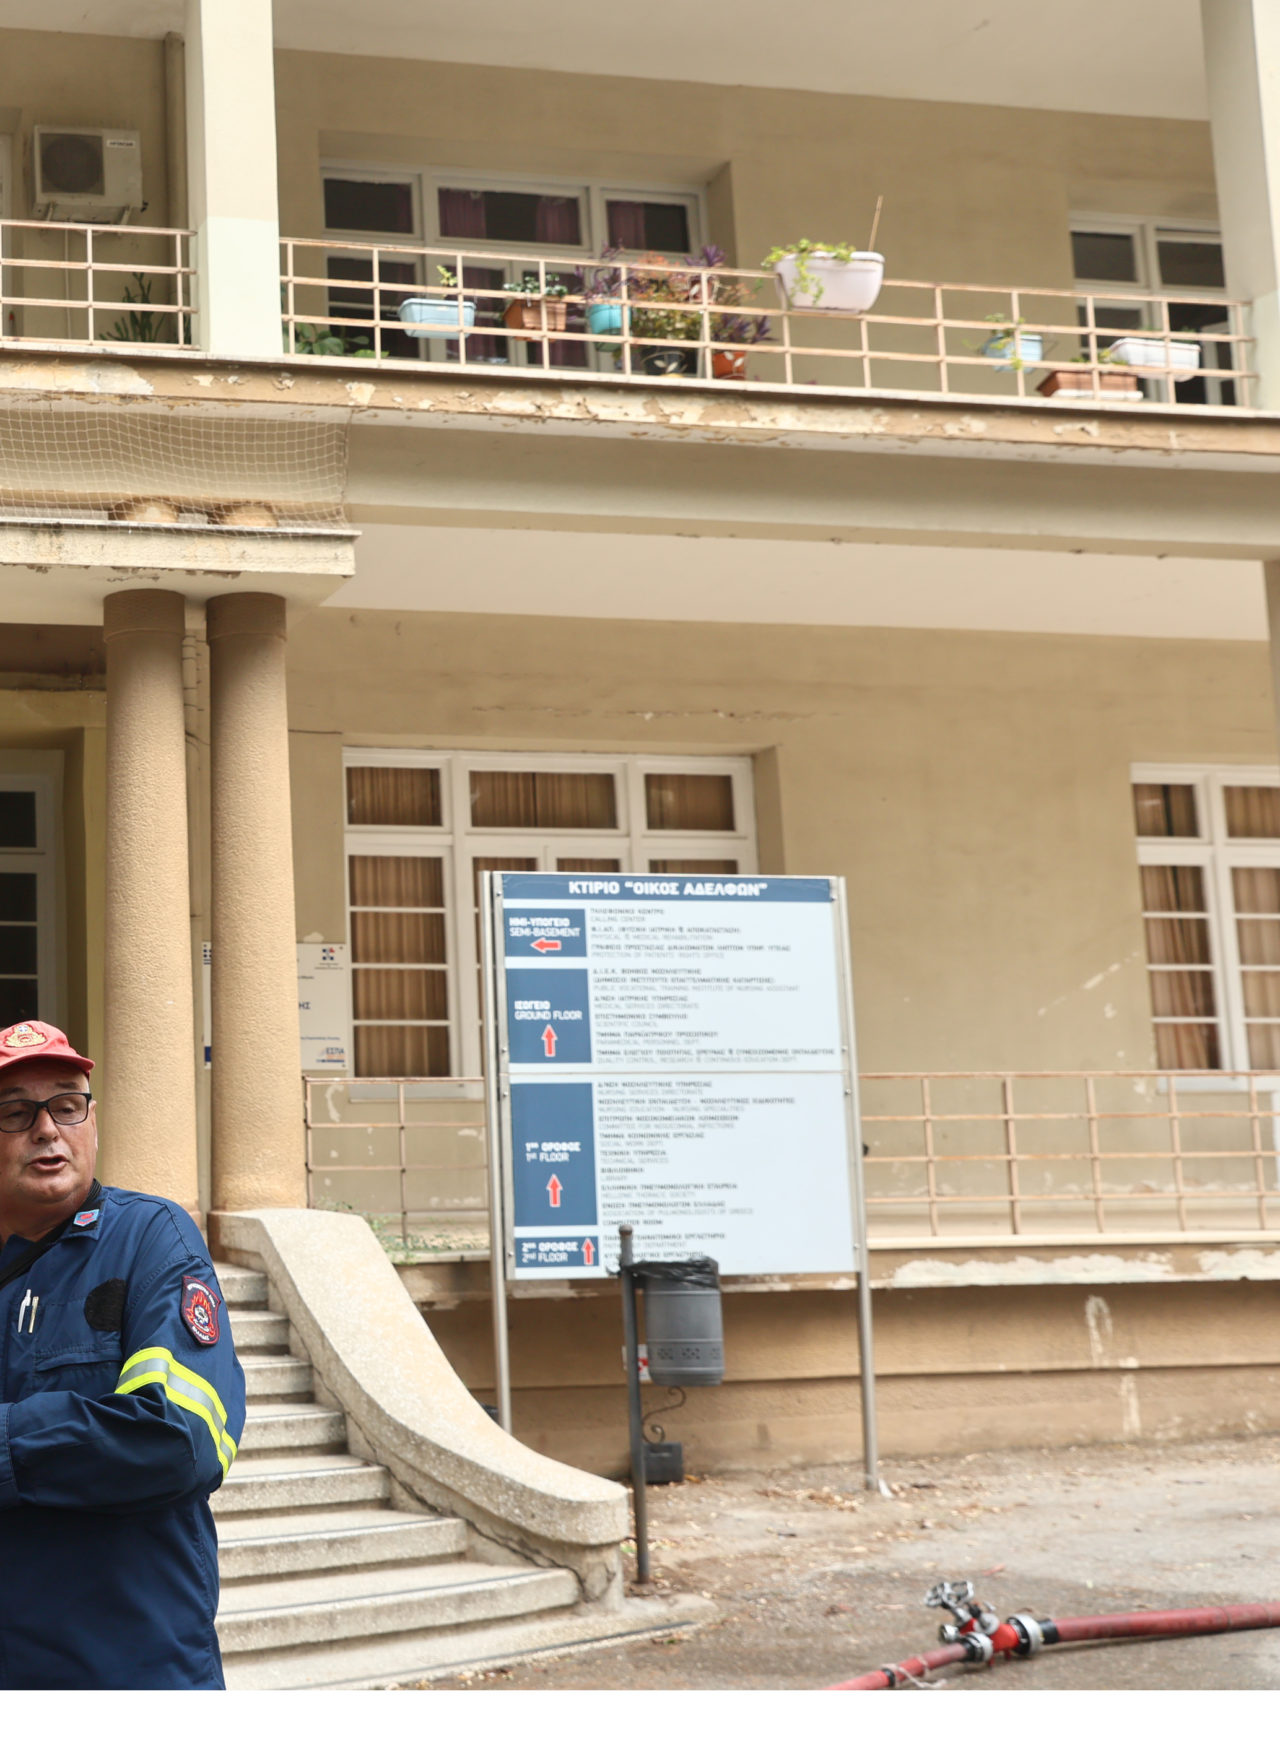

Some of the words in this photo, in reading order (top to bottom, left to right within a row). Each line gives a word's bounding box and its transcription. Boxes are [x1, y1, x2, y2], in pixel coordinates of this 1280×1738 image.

[569, 881, 620, 895] ΚΤΙΡΙΟ
[515, 1011, 551, 1020] GROUND
[553, 1011, 583, 1020] FLOOR
[540, 1152, 570, 1162] FLOOR
[538, 1252, 569, 1262] FLOOR
